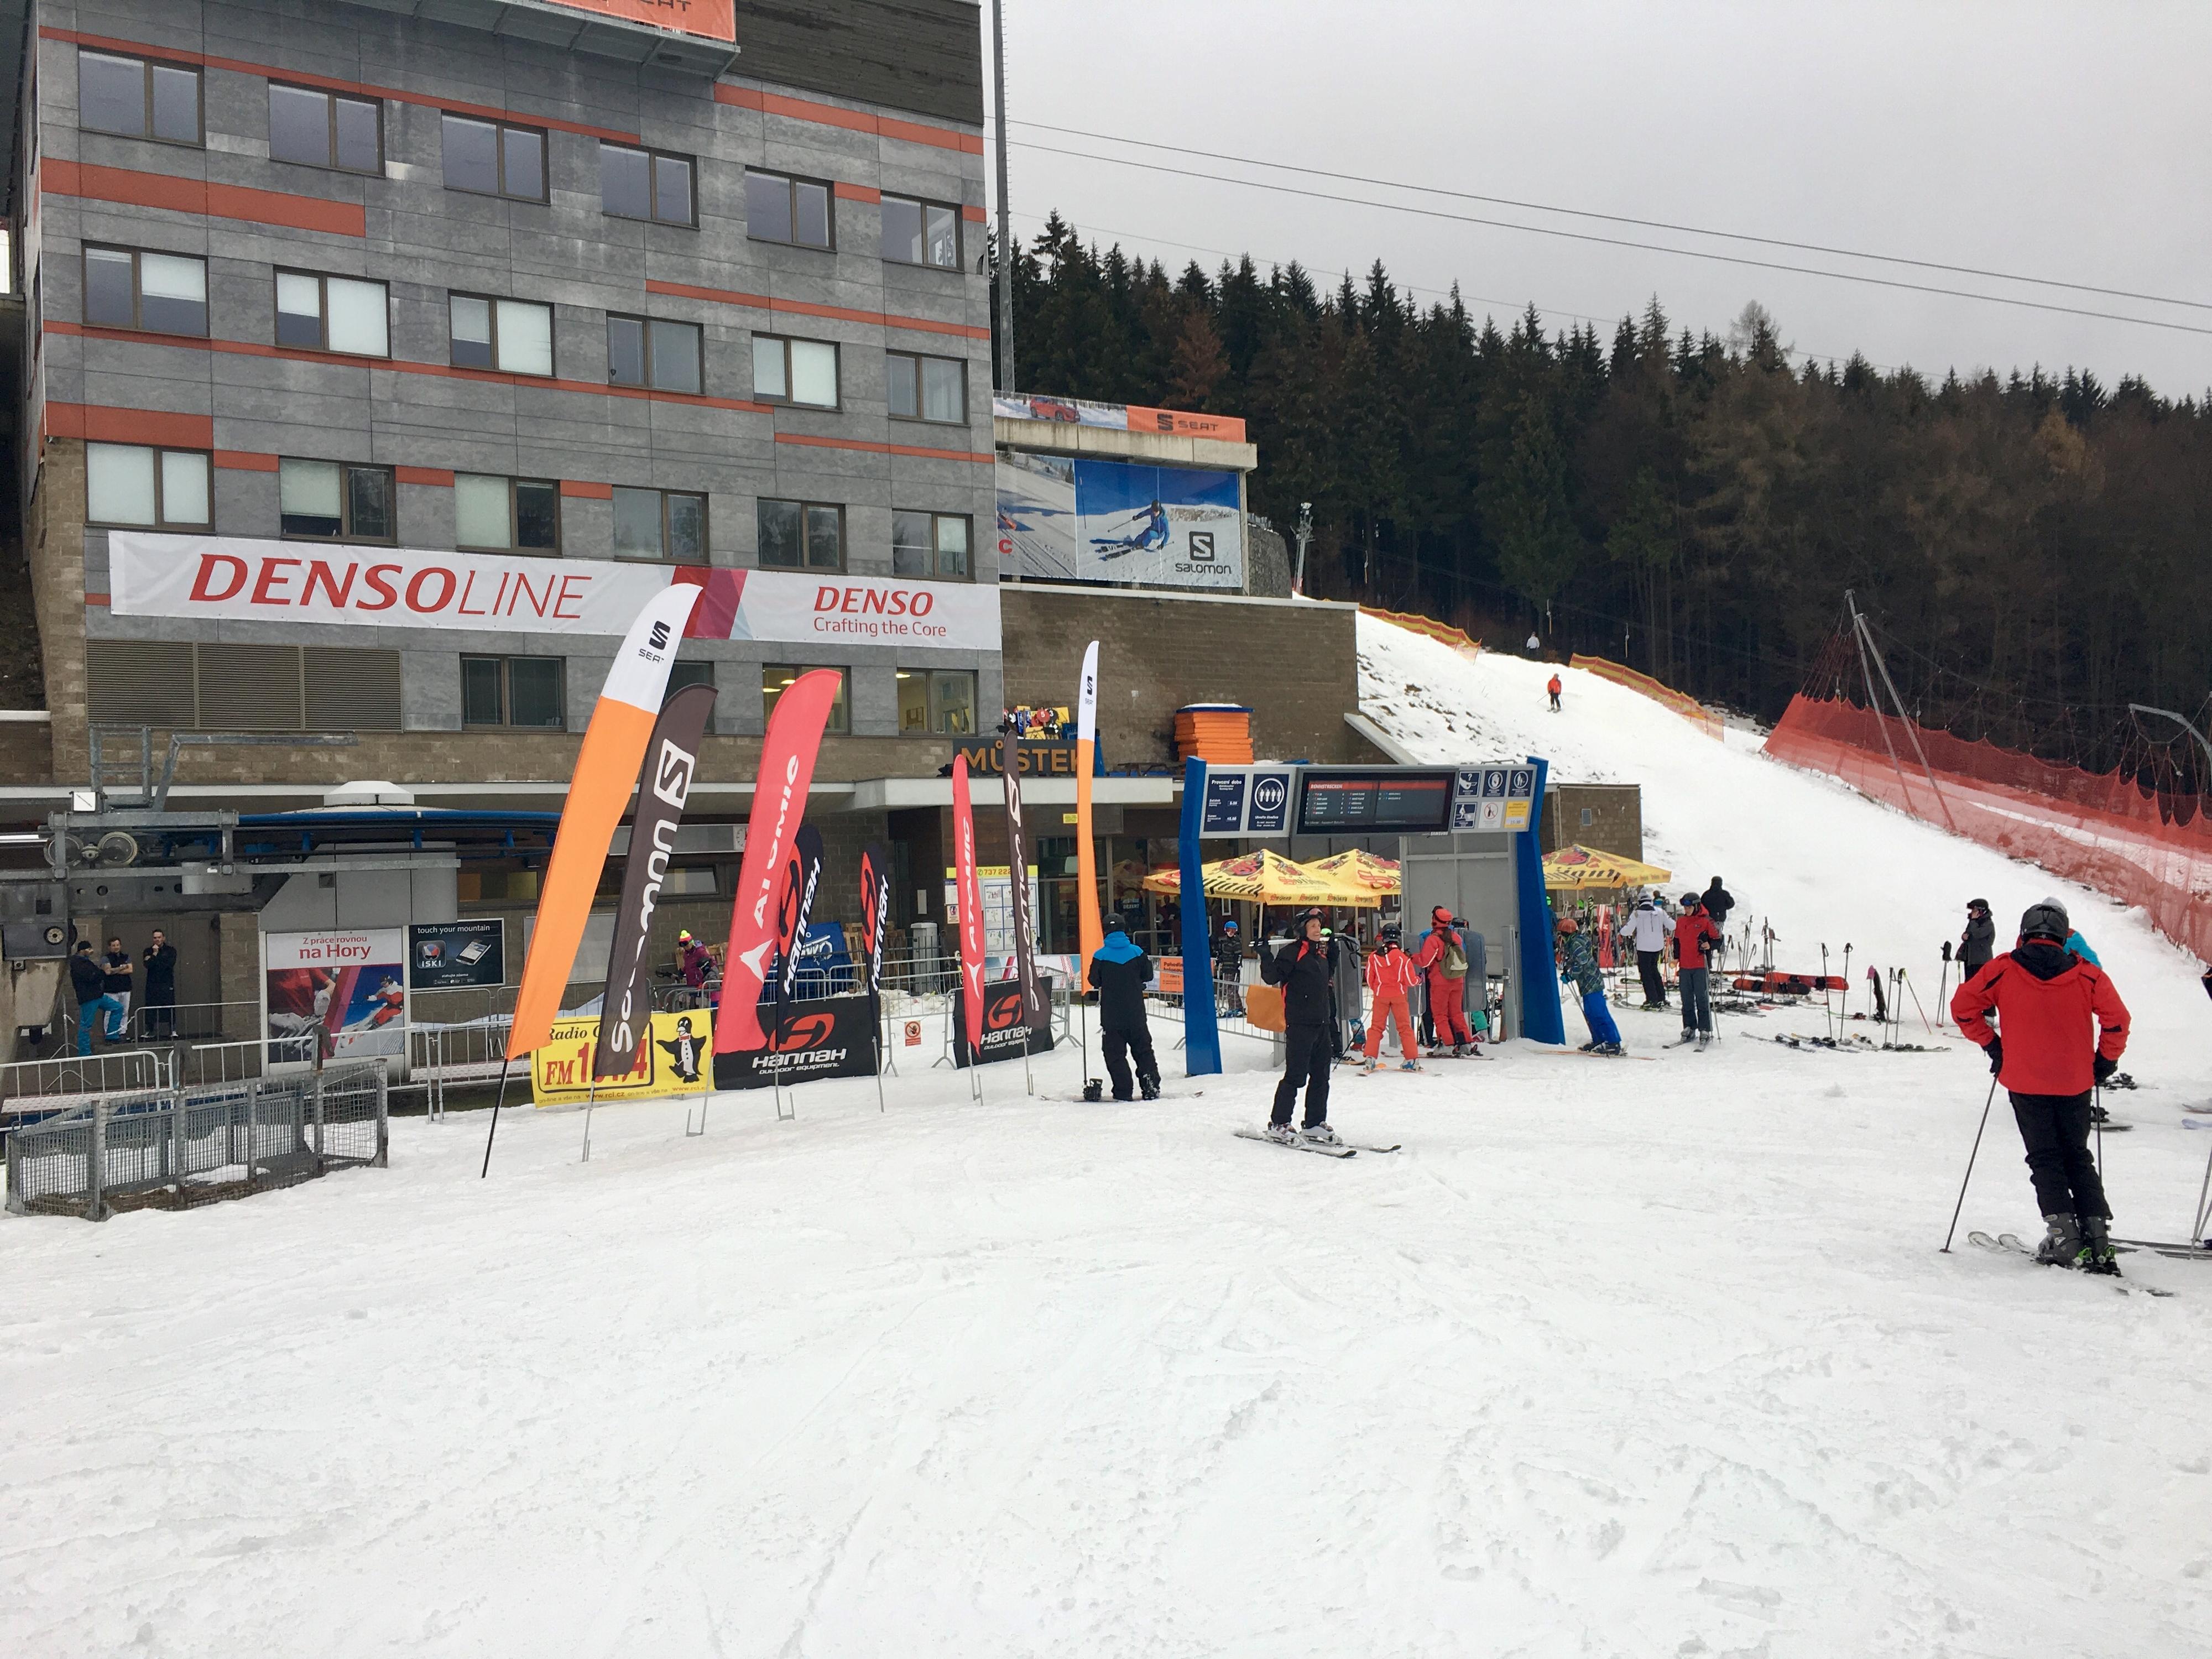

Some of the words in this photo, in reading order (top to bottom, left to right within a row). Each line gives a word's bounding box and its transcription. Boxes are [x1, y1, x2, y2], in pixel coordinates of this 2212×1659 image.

[1177, 420, 1218, 431] SEAT
[189, 554, 593, 618] DENSOLINE
[814, 586, 933, 617] DENSO
[813, 617, 878, 637] Crafting
[882, 620, 908, 635] the
[912, 622, 946, 636] Core
[457, 924, 490, 932] mountain
[310, 936, 334, 946] práce
[299, 948, 321, 959] na
[326, 944, 372, 959] Hory
[545, 1060, 575, 1086] FM
[796, 1062, 840, 1071] equipment
